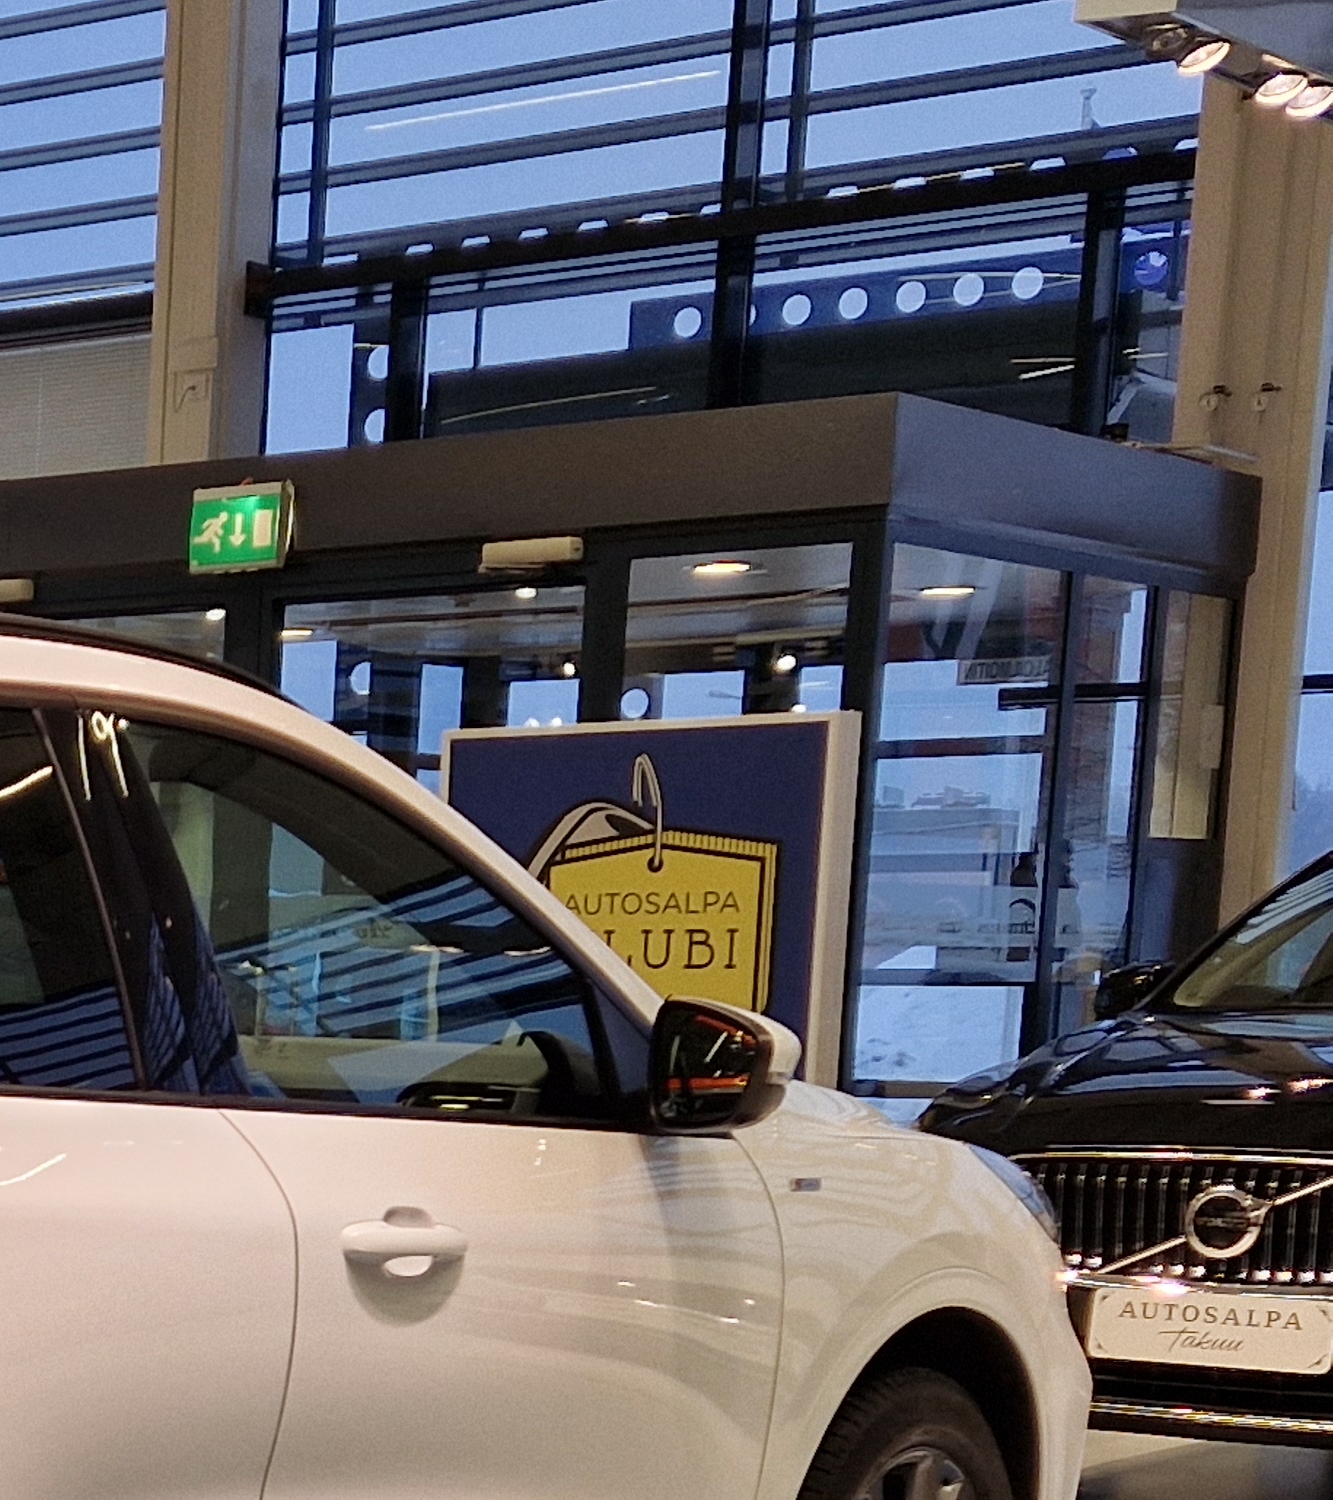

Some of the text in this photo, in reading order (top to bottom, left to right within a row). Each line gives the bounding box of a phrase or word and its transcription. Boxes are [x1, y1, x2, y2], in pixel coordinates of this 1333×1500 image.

[565, 891, 740, 915] AUTOSALPA
[593, 928, 739, 969] UBI
[1119, 1301, 1303, 1330] AUTOSALPA
[1158, 1328, 1244, 1353] Takuu
